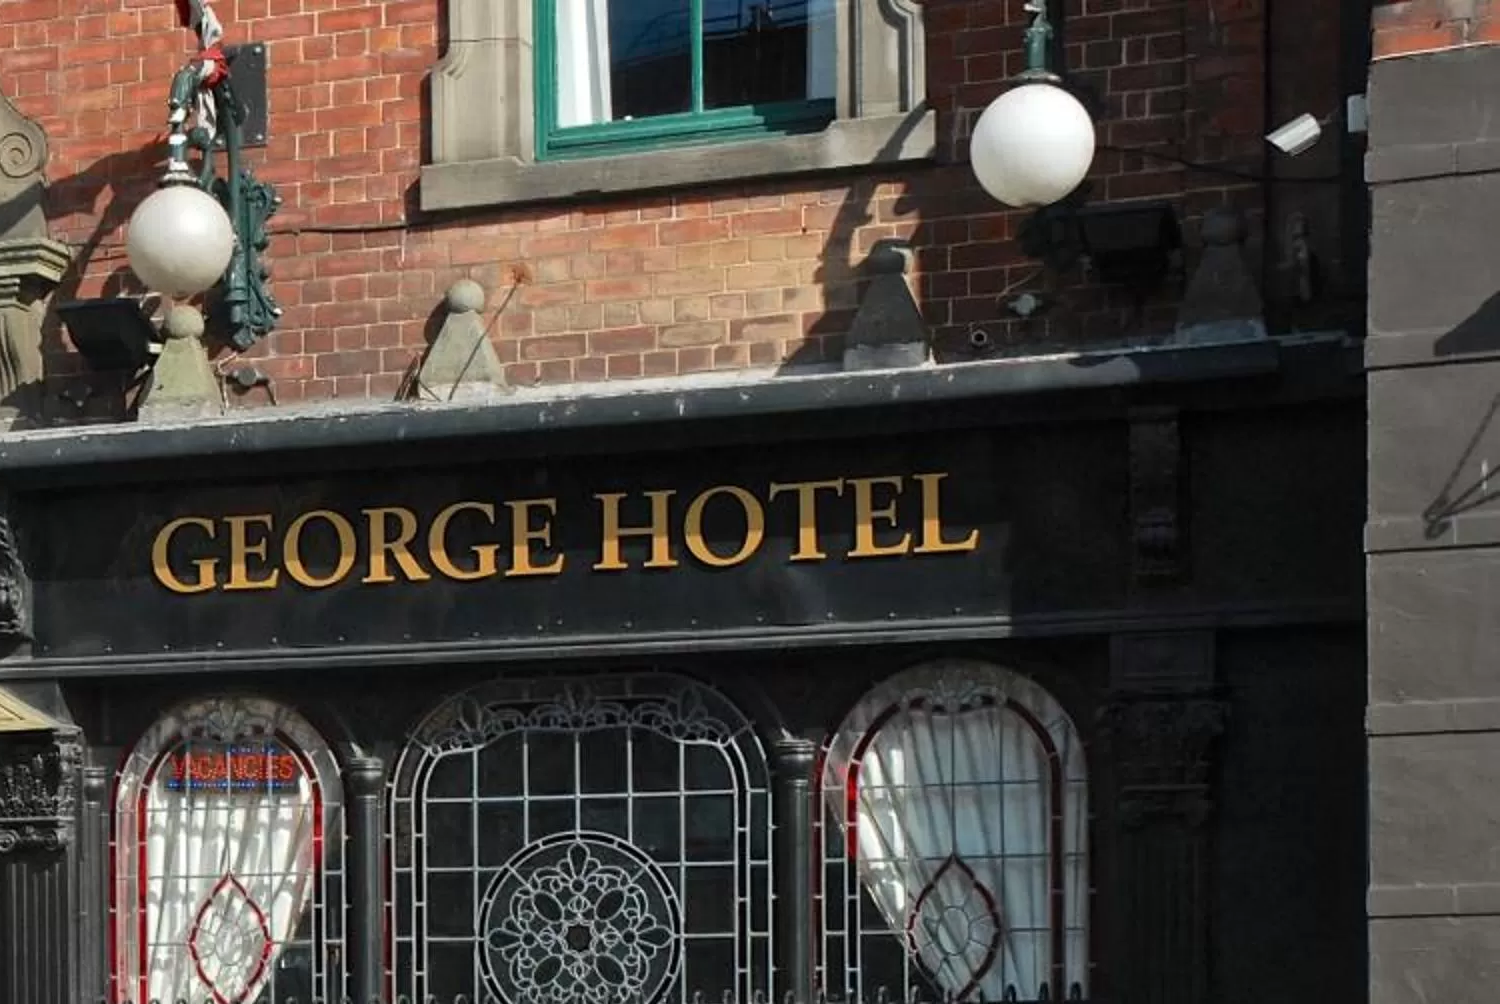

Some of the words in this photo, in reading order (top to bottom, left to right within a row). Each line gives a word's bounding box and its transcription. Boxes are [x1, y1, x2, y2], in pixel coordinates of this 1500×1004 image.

[150, 496, 565, 595] GEORGE
[592, 471, 981, 574] HOTEL
[169, 753, 295, 780] VACANCIES
